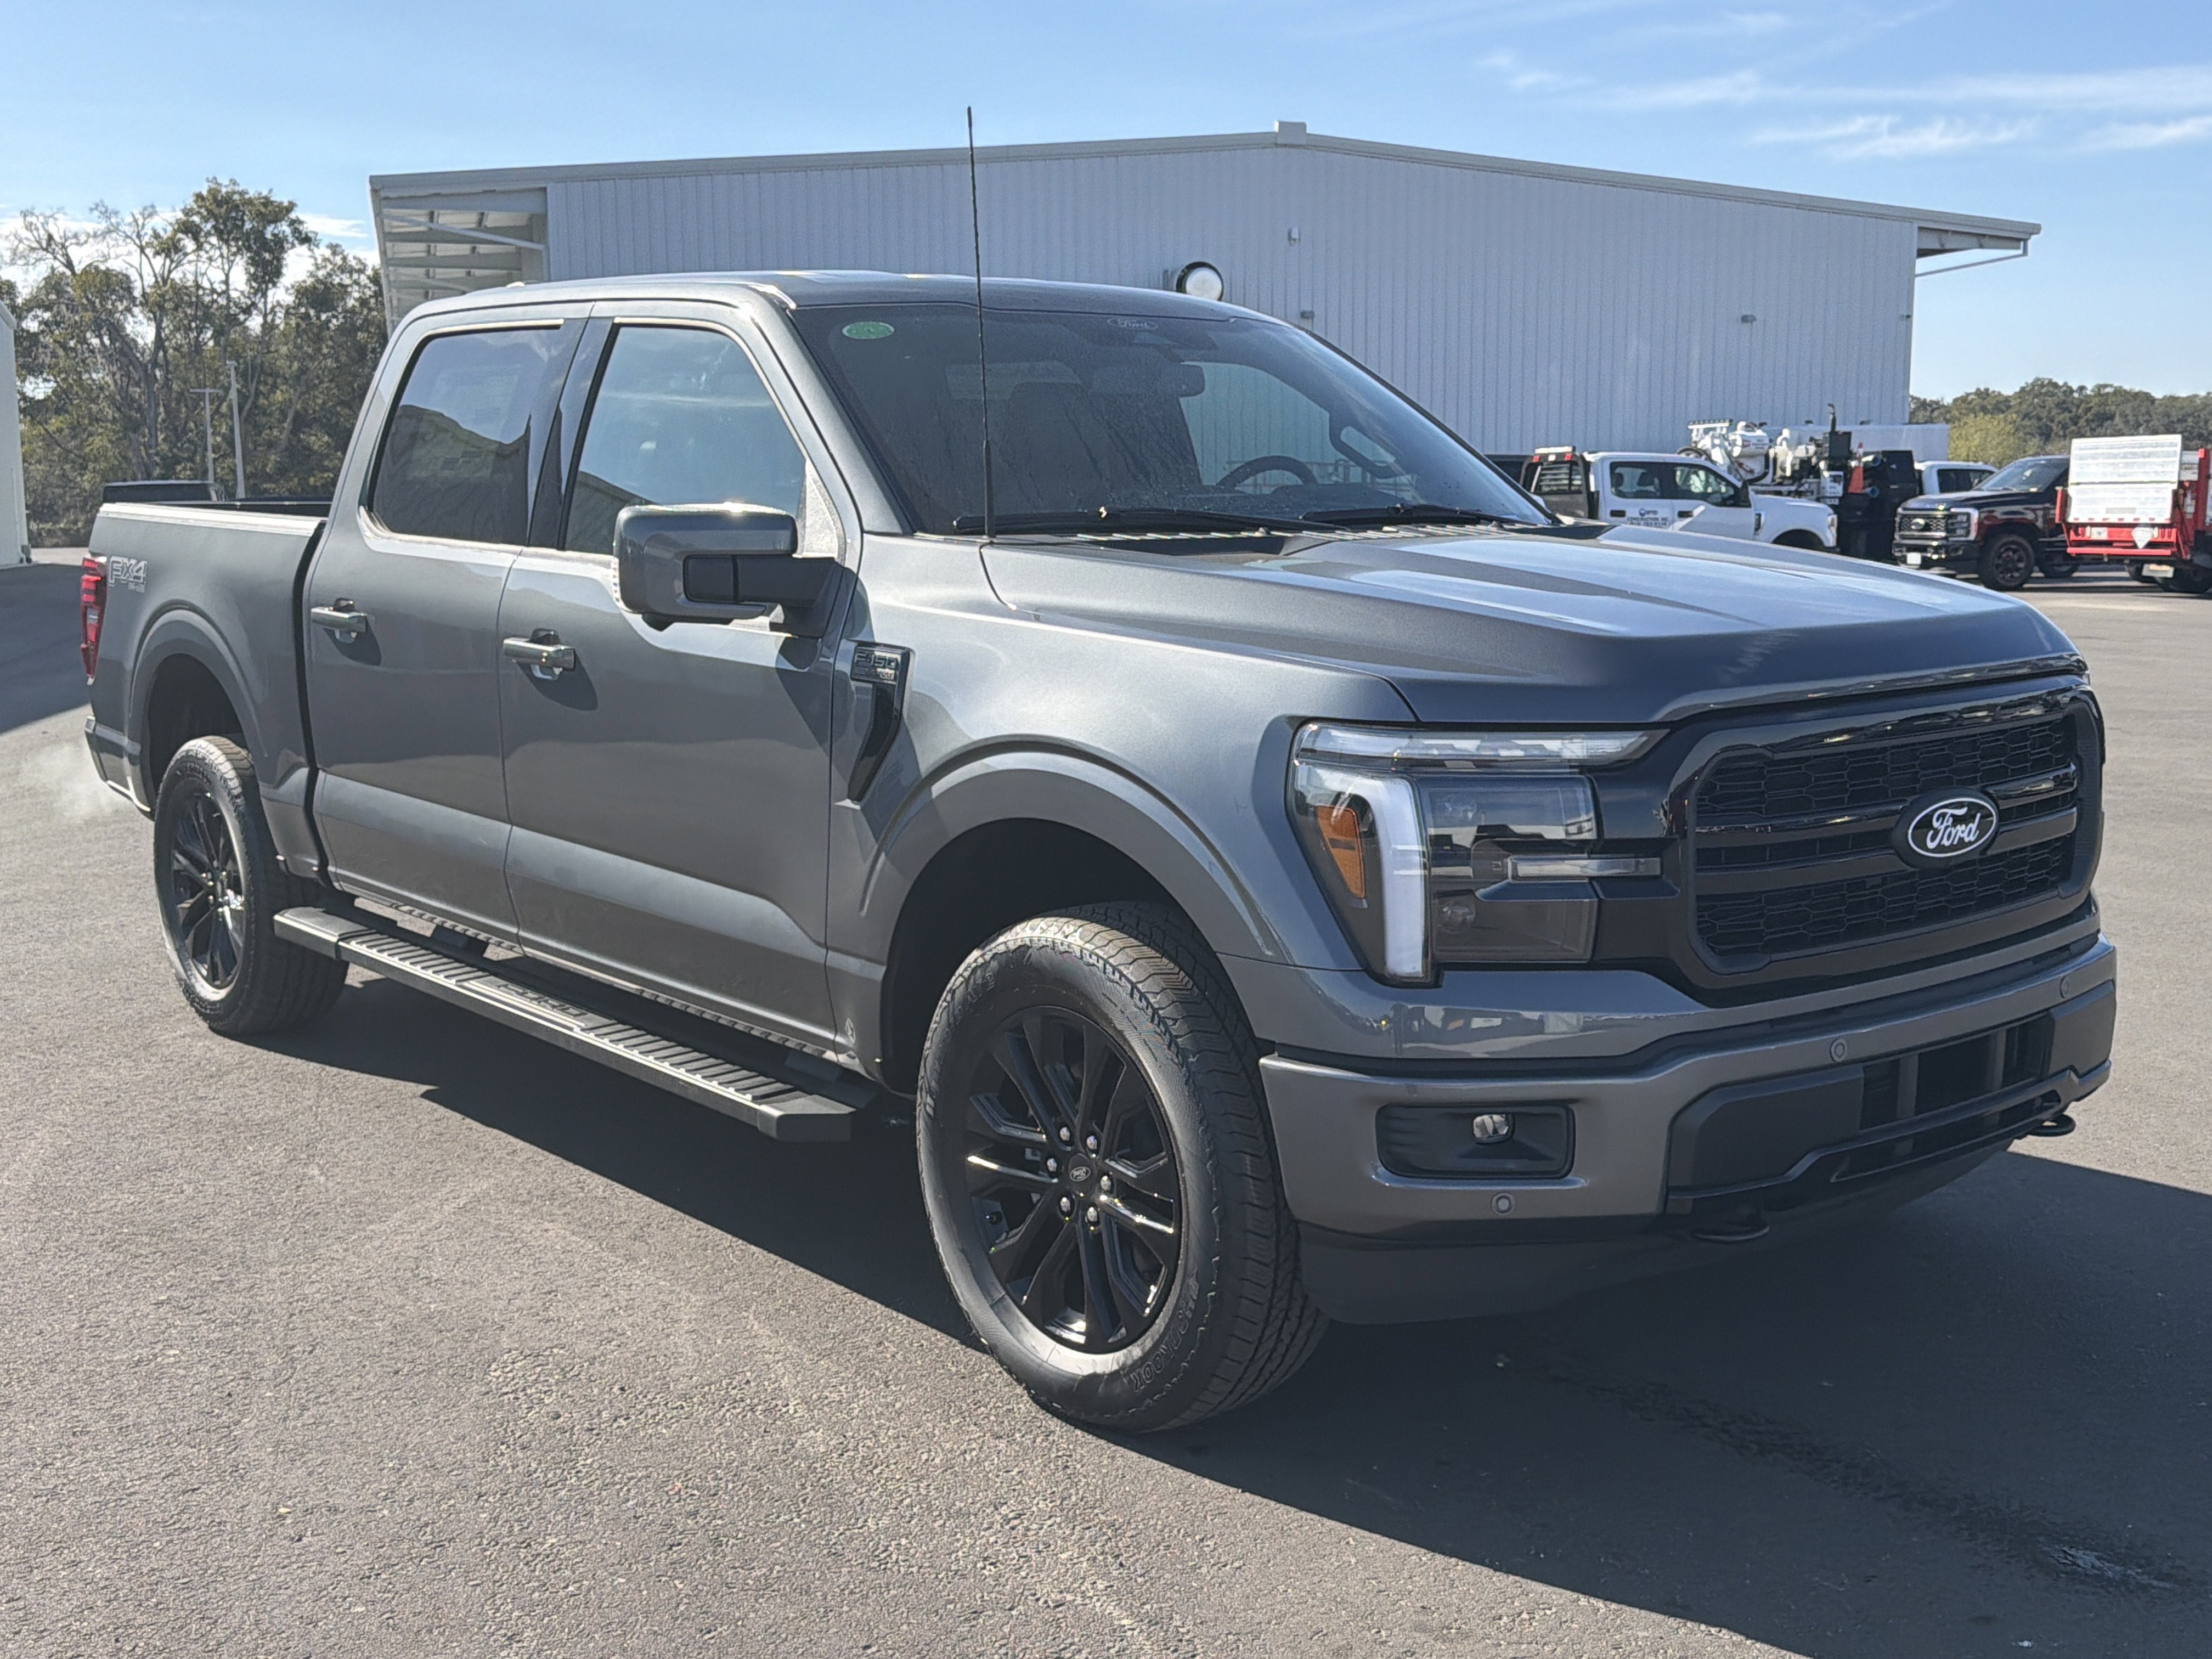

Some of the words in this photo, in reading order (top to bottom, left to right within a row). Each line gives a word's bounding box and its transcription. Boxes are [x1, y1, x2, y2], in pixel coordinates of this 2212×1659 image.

[108, 556, 148, 586] FX4
[854, 652, 897, 668] F-150
[1926, 806, 1982, 849] Ford
[496, 984, 588, 1018] FORD
